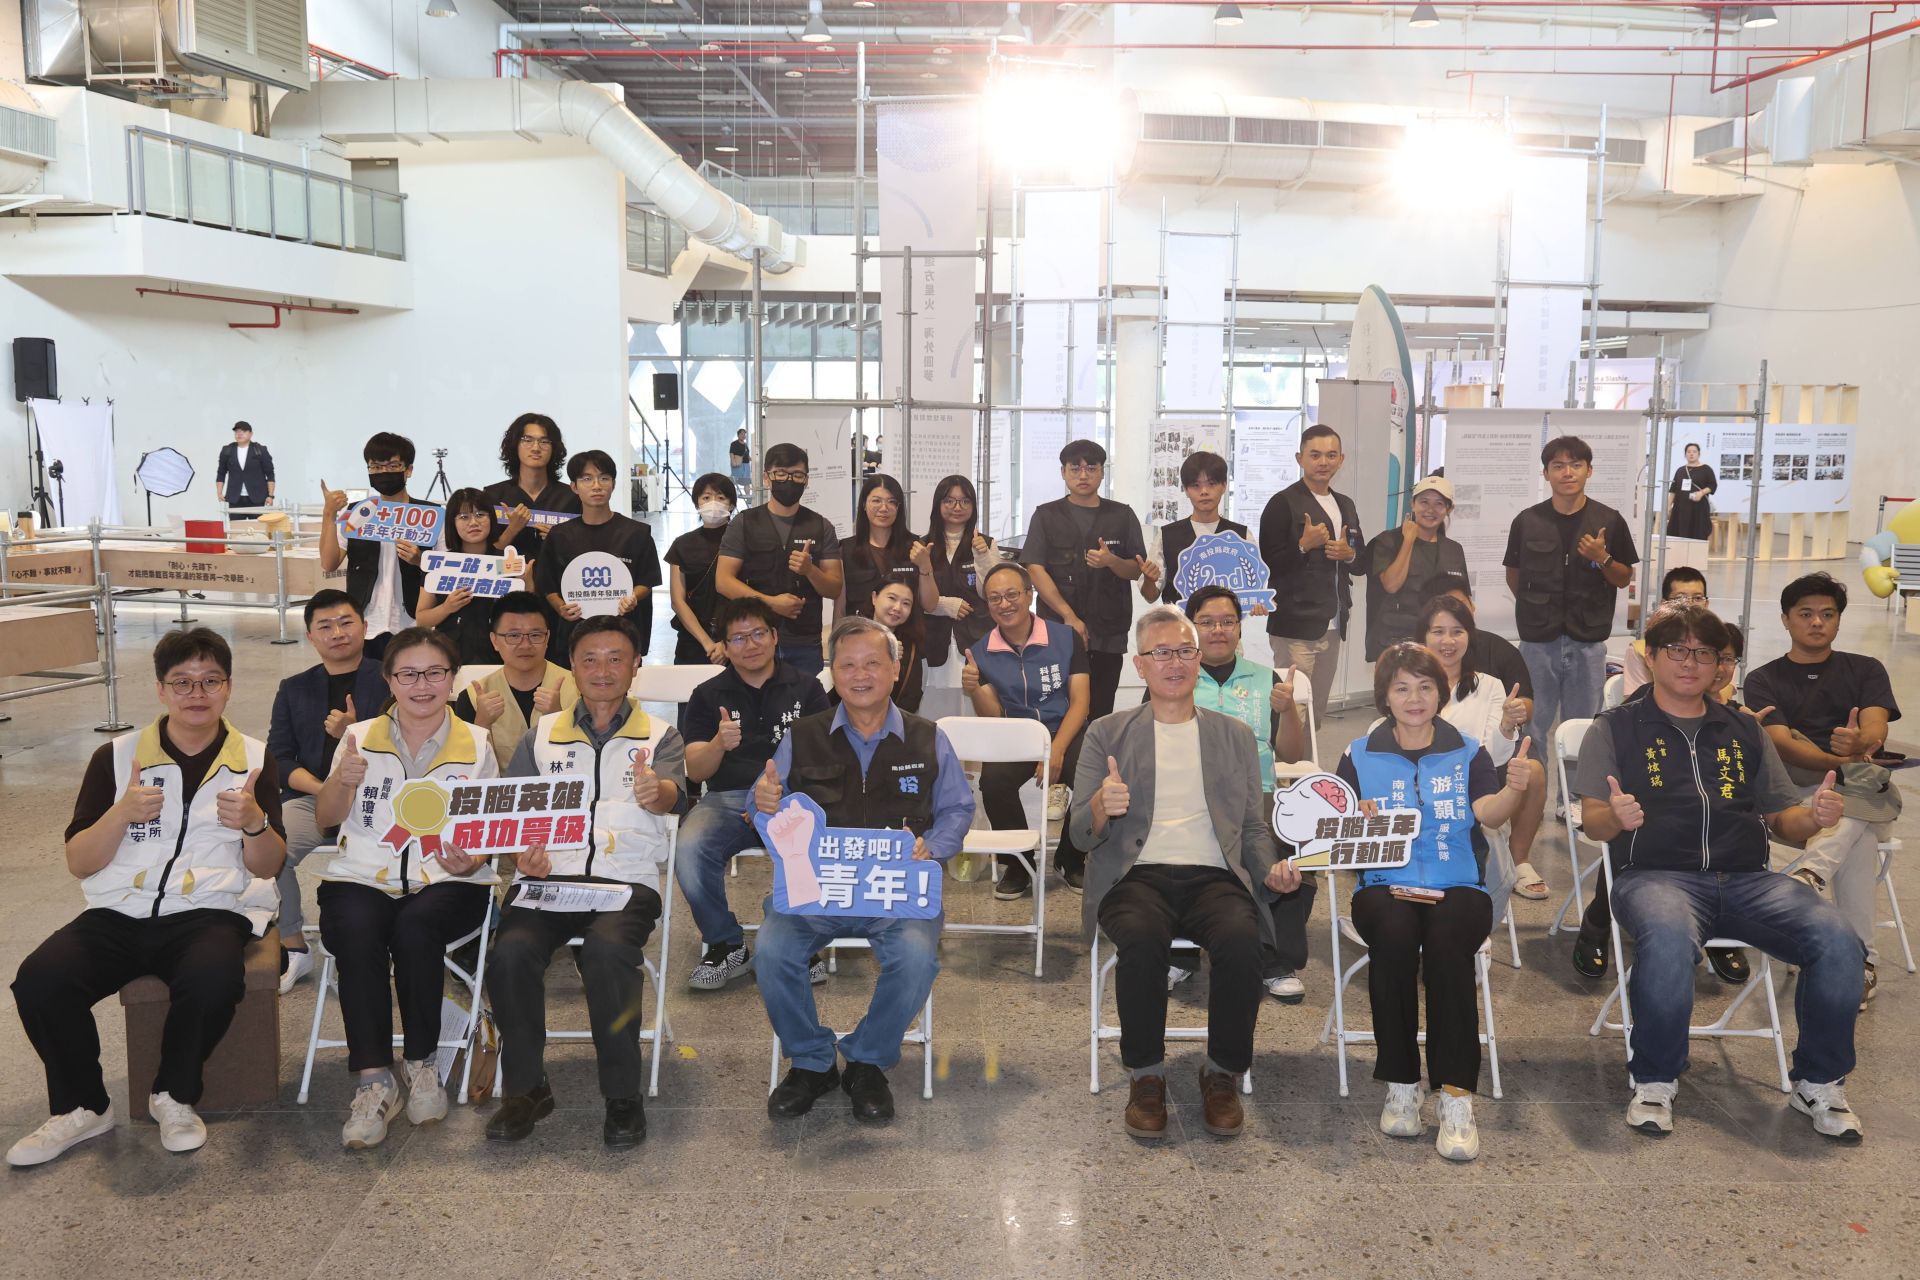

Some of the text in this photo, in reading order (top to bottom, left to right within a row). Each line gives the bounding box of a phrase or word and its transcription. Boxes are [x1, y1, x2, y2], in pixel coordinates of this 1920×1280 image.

[377, 506, 437, 529] +100
[362, 523, 432, 544] 青年行動力
[436, 575, 512, 595] 改變南投
[567, 589, 628, 599] 南投縣青年發展所
[549, 760, 563, 774] 林
[565, 750, 576, 769] 局長
[1731, 738, 1746, 784] 立法委員
[1716, 748, 1735, 799] 馬文君
[449, 780, 585, 817] 投腦英雄
[1454, 771, 1466, 820] 立法委員
[451, 814, 586, 850] 成功晉級
[1315, 814, 1417, 840] 投腦青年
[1329, 839, 1407, 866] 行動派
